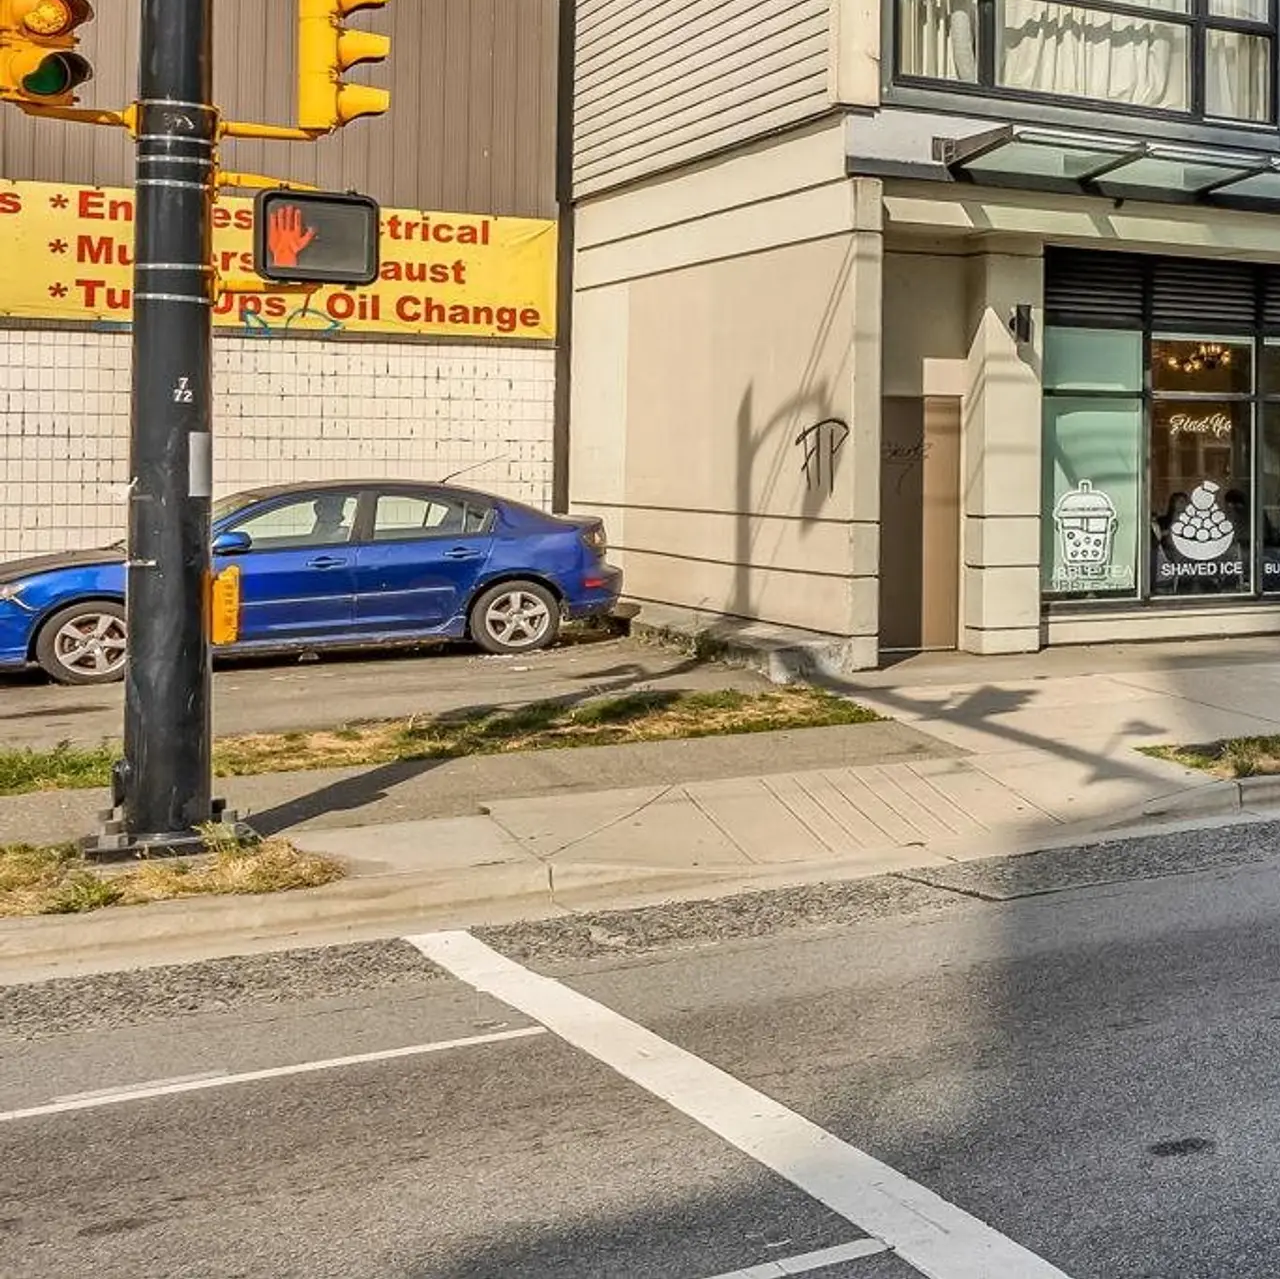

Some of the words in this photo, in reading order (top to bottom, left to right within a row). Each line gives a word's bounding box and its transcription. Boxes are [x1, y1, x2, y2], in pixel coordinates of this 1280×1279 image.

[325, 291, 380, 321] Oil
[395, 294, 541, 333] Change
[178, 377, 189, 390] 7
[174, 389, 193, 402] 72
[1161, 561, 1218, 577] SHAVED
[1220, 560, 1243, 575] ICE
